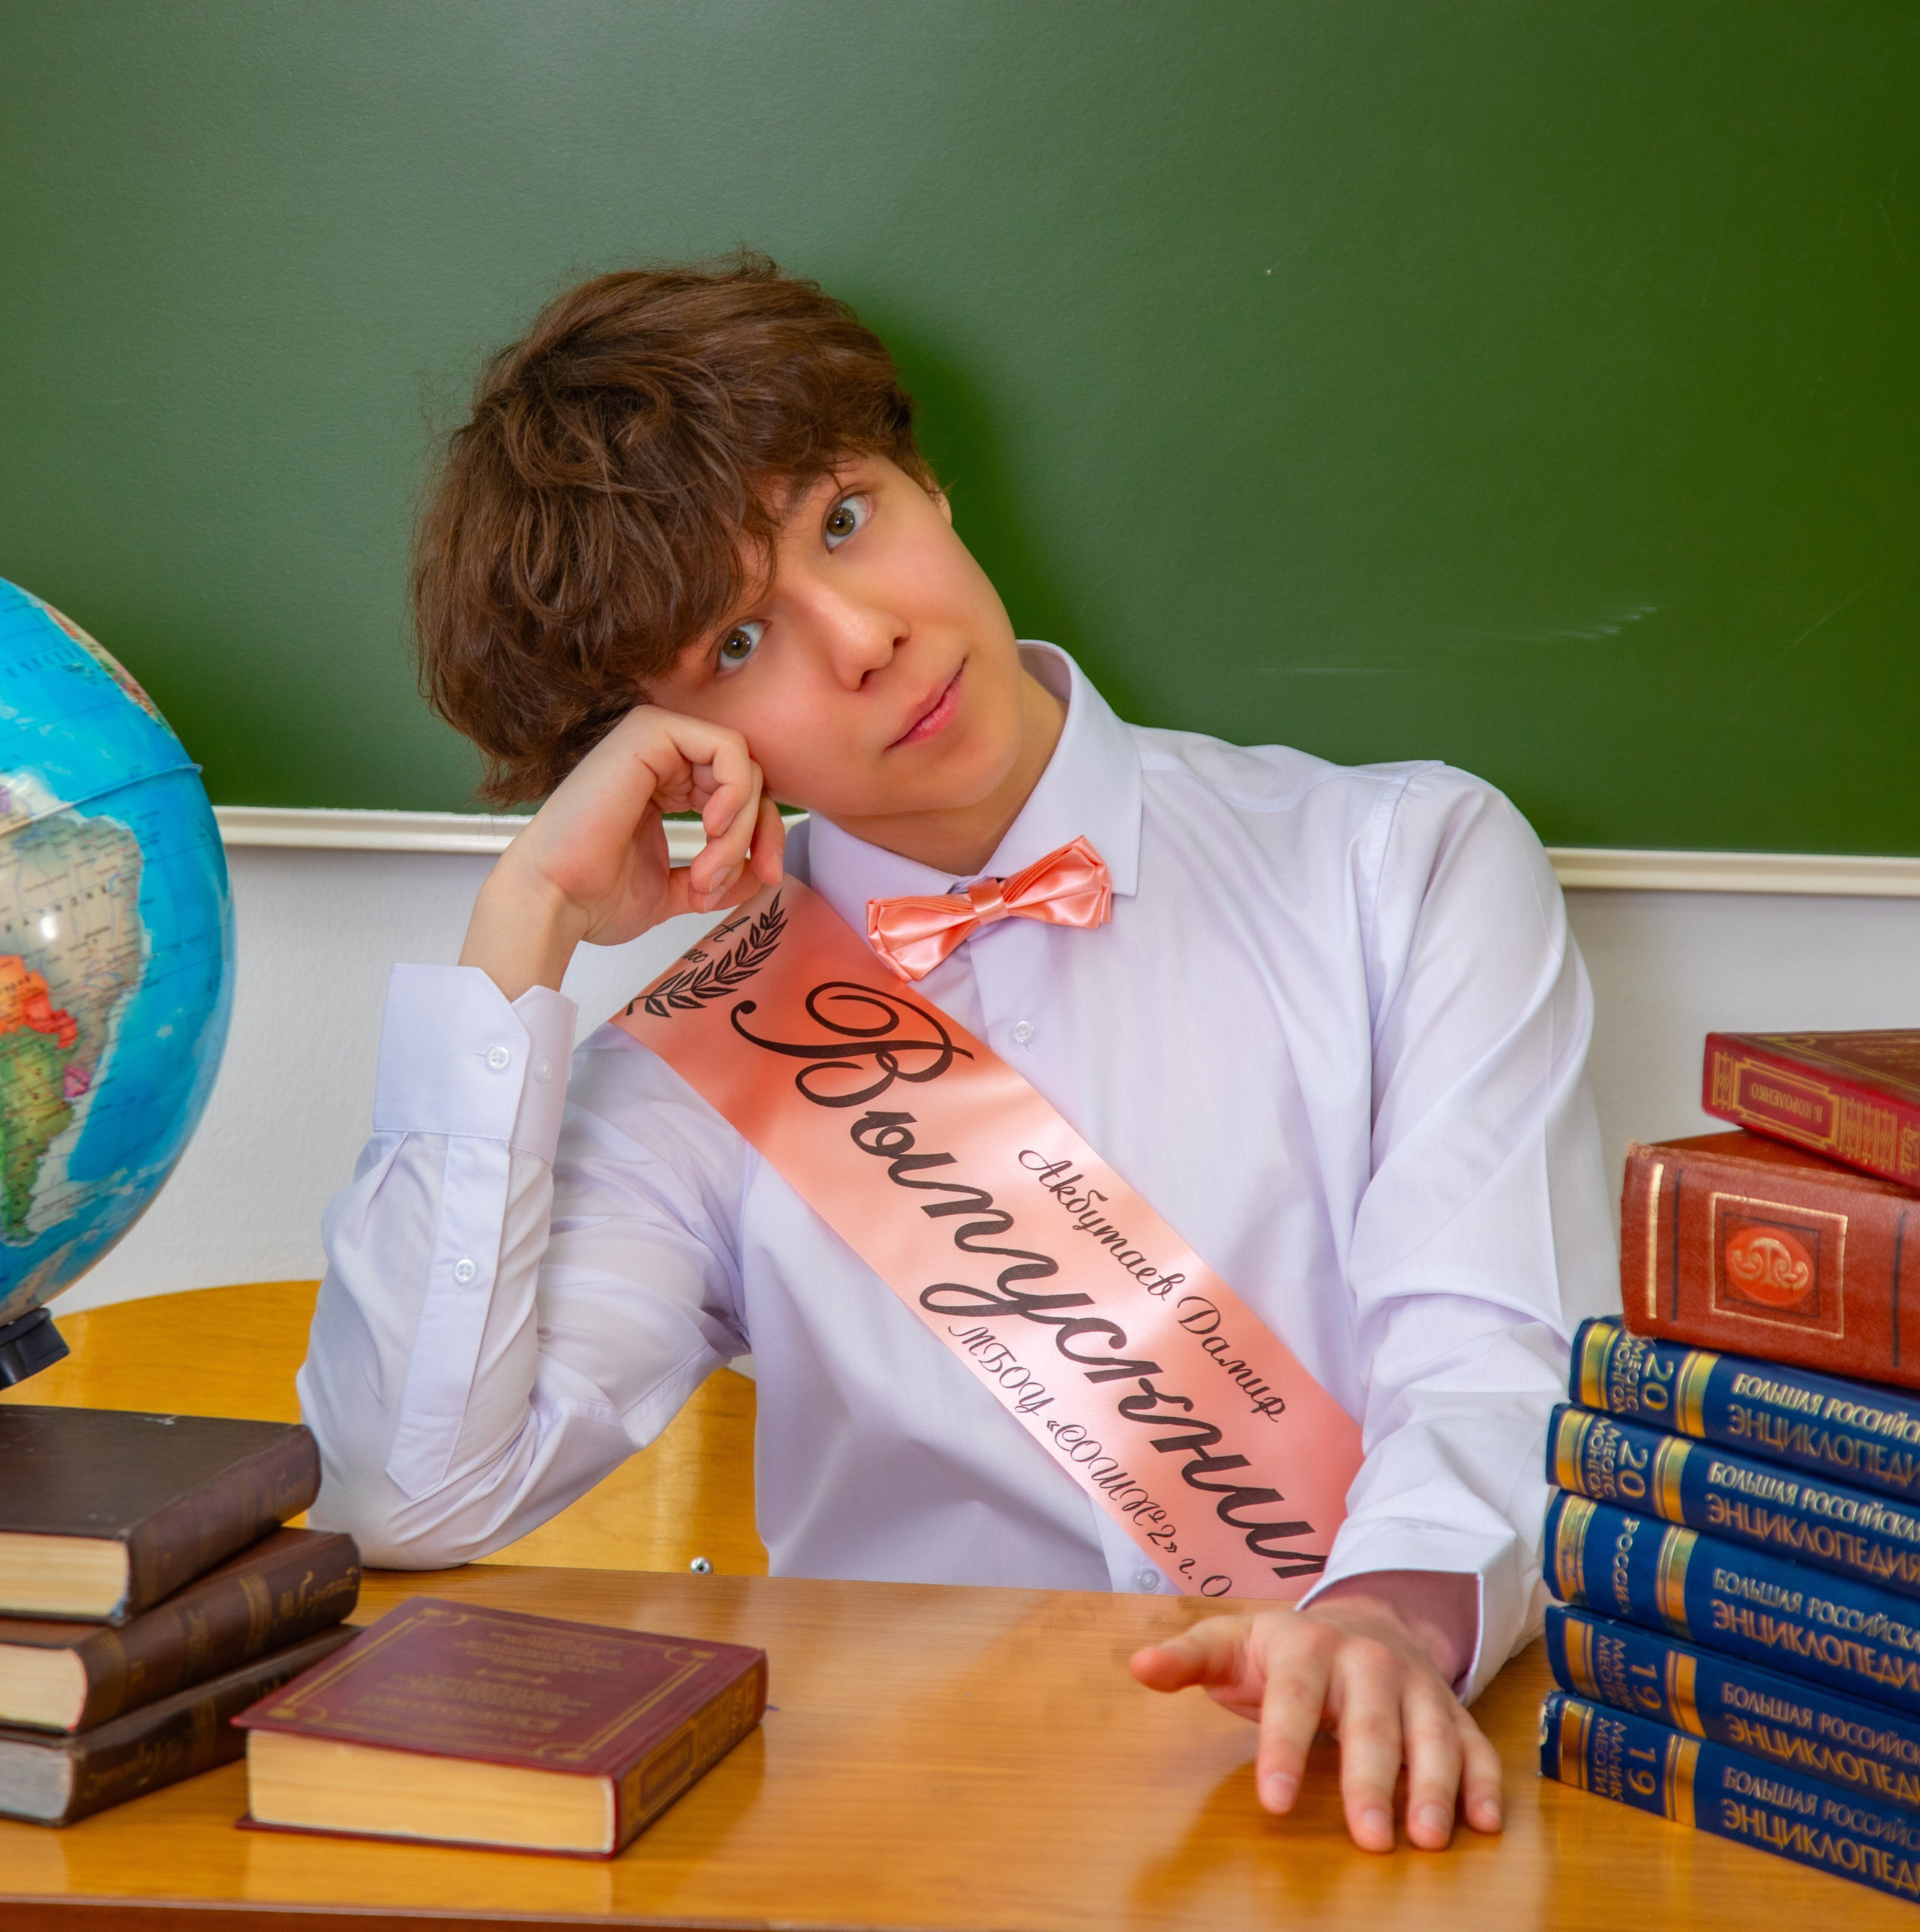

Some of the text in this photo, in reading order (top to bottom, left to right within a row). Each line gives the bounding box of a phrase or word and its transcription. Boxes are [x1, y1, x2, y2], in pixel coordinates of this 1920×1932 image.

[1750, 1082, 1812, 1119] КОРОЛЕНКО
[1018, 1150, 1286, 1423] Акбутаев Дамир
[948, 1326, 1055, 1416] МБОУ
[1611, 1332, 1634, 1414] МОНГОЛ
[1625, 1340, 1648, 1412] МЕОТС
[1641, 1352, 1674, 1411] 20
[1731, 1372, 1824, 1416] БОЛЬШАЯ
[1588, 1417, 1612, 1499] МОНГОЛ
[1603, 1427, 1623, 1499] МЕОТС
[1618, 1439, 1649, 1498] 20
[1707, 1460, 1798, 1507] БОЛЬШАЯ
[1713, 1567, 1803, 1612] БОЛЬШАЯ
[1630, 1663, 1662, 1709] 19
[1721, 1681, 1813, 1731] БОЛЬШАЯ
[1594, 1717, 1612, 1794] МЕОТИ
[1609, 1720, 1628, 1802] МАНИК
[1628, 1746, 1657, 1796] 19
[1723, 1713, 1920, 1807] ЭНЦИКЛОПЕД
[1722, 1766, 1818, 1816] БОЛЬШАЯ
[1720, 1798, 1920, 1897] ЭНЦИКЛОПЕД
